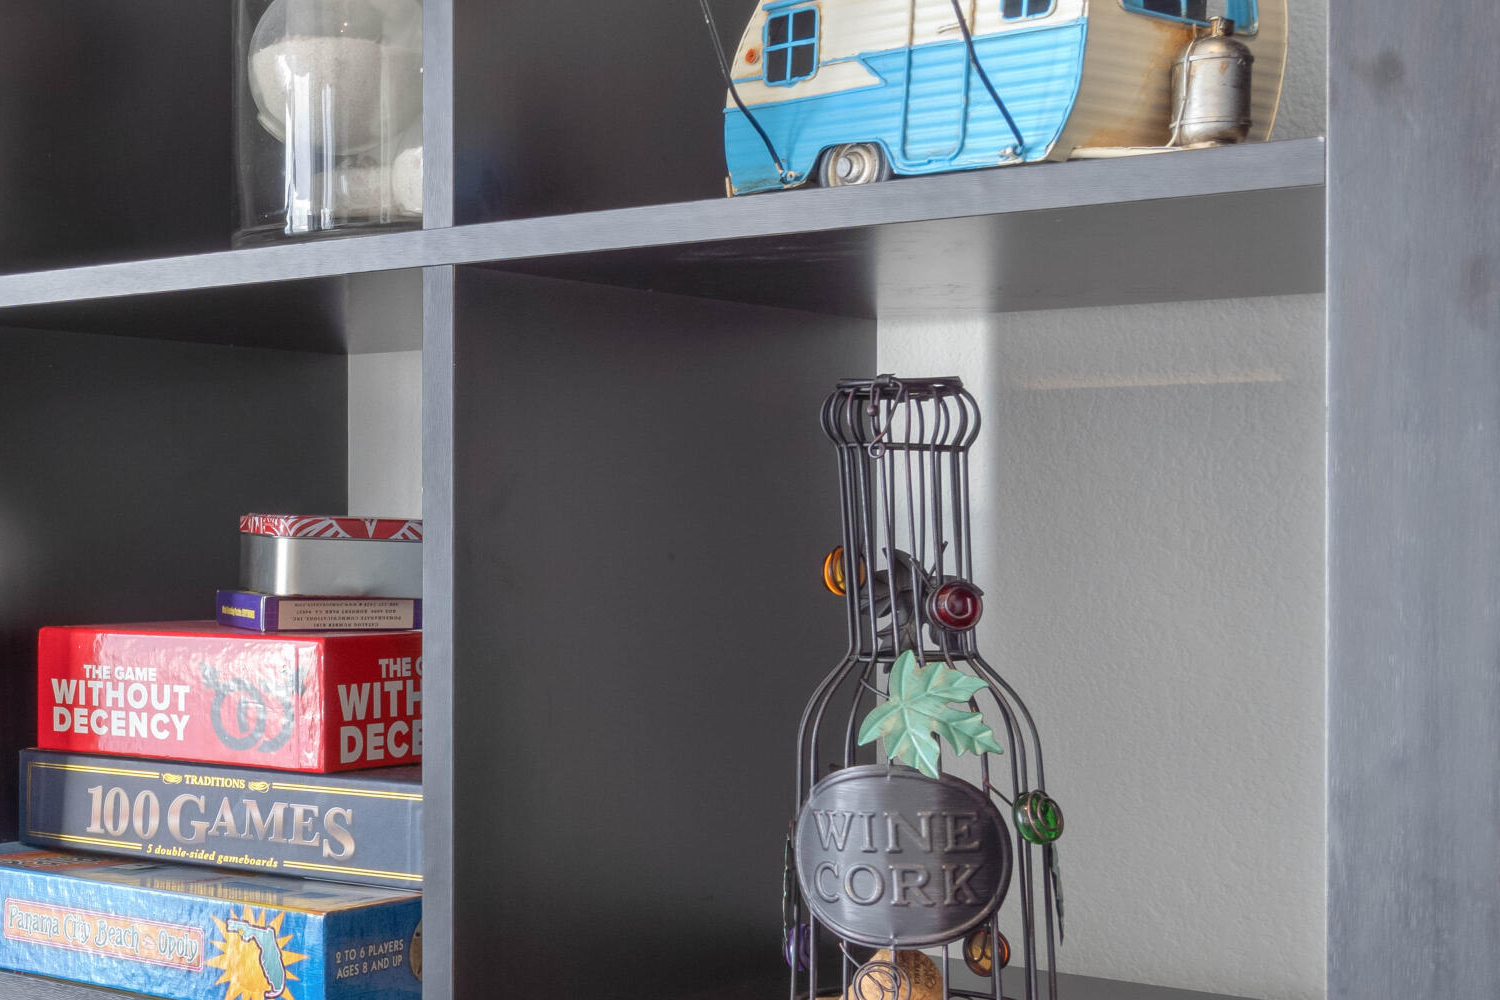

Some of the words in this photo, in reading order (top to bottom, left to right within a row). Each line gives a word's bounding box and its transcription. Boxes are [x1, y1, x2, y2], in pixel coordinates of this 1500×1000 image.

[83, 664, 111, 679] THE
[114, 666, 156, 682] GAME
[378, 657, 412, 678] THE
[51, 678, 190, 712] WITHOUT
[53, 706, 190, 741] DECENCY
[184, 774, 246, 790] TRADITIONS
[86, 785, 160, 840] 100
[167, 793, 356, 862] GAMES
[812, 809, 981, 853] WINE
[146, 843, 153, 854] 5
[154, 845, 215, 861] double-sided
[217, 853, 279, 869] gameboards
[813, 860, 983, 907] CORK
[8, 904, 61, 938] Panama
[63, 914, 92, 945] City
[94, 920, 141, 953] Beach
[157, 928, 199, 962] Opoly
[336, 951, 341, 963] 2
[344, 948, 356, 962] TO
[360, 947, 365, 958] 6
[368, 939, 404, 957] PLAYERS
[336, 963, 359, 980] AGES
[362, 961, 368, 973] 8
[370, 957, 389, 972] AND
[392, 954, 403, 967] UP
